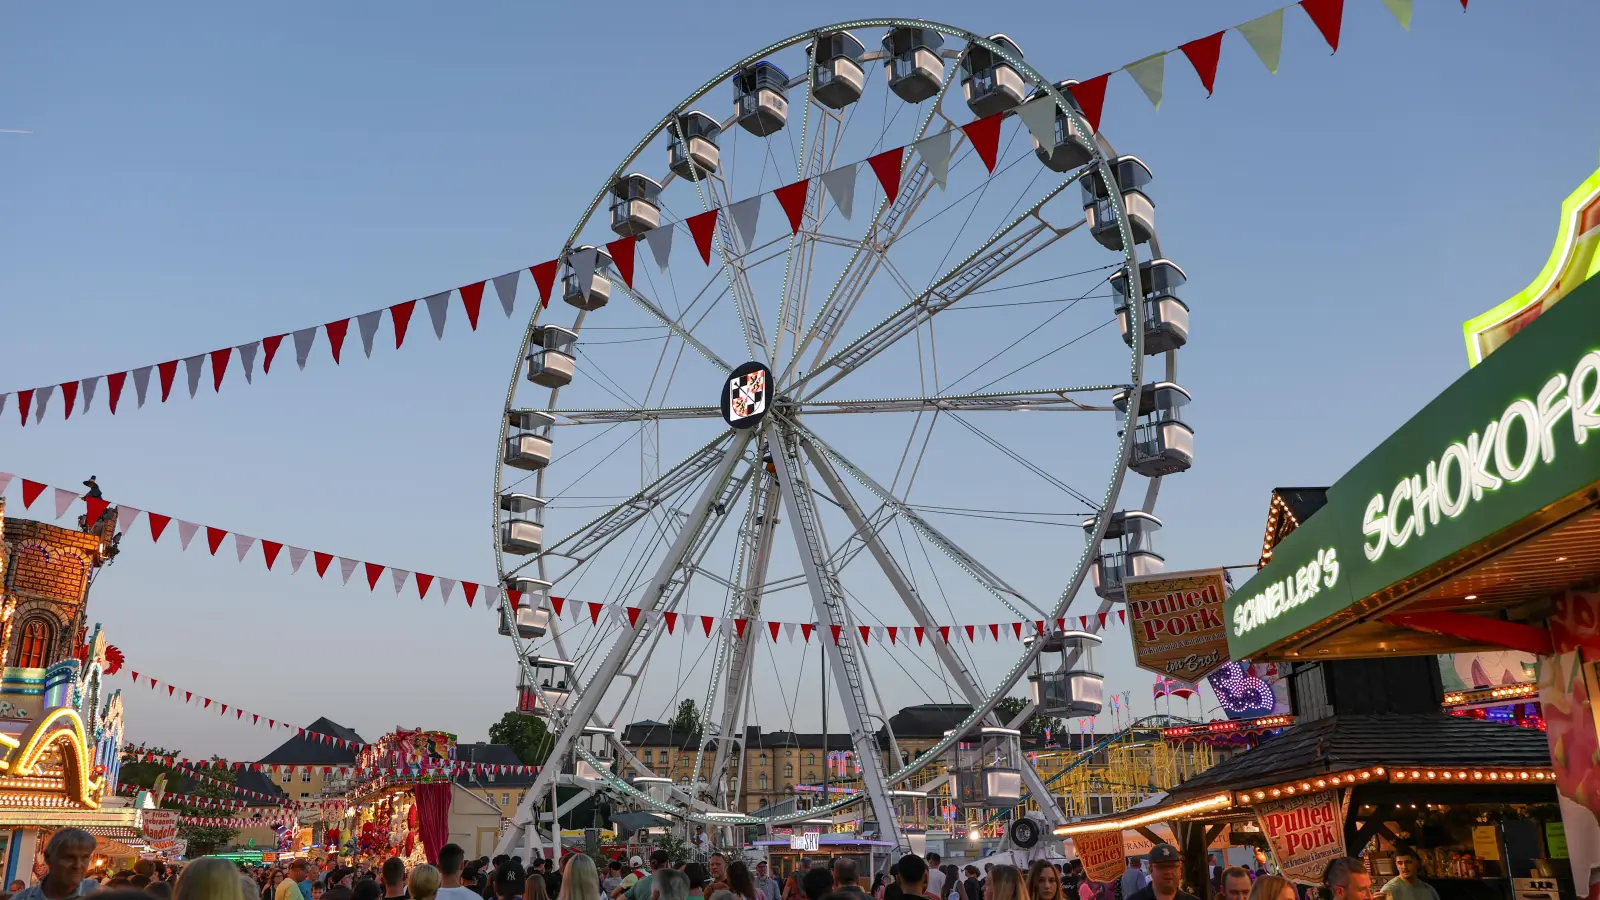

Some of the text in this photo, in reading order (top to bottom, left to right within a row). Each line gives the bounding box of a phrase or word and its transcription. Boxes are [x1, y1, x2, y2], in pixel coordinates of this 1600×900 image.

[1130, 584, 1221, 620] Pulled
[1232, 547, 1340, 637] SCHNELLER'S
[1142, 607, 1224, 642] Pork
[1183, 649, 1220, 672] Brot
[1309, 790, 1332, 809] NEU!
[144, 818, 176, 826] gebrannte
[1266, 801, 1335, 838] Pulled
[143, 824, 177, 841] Mandeln
[805, 832, 819, 850] SKY
[1080, 832, 1119, 855] Pulled
[1284, 824, 1336, 857] Pork
[1083, 845, 1122, 868] Turkey
